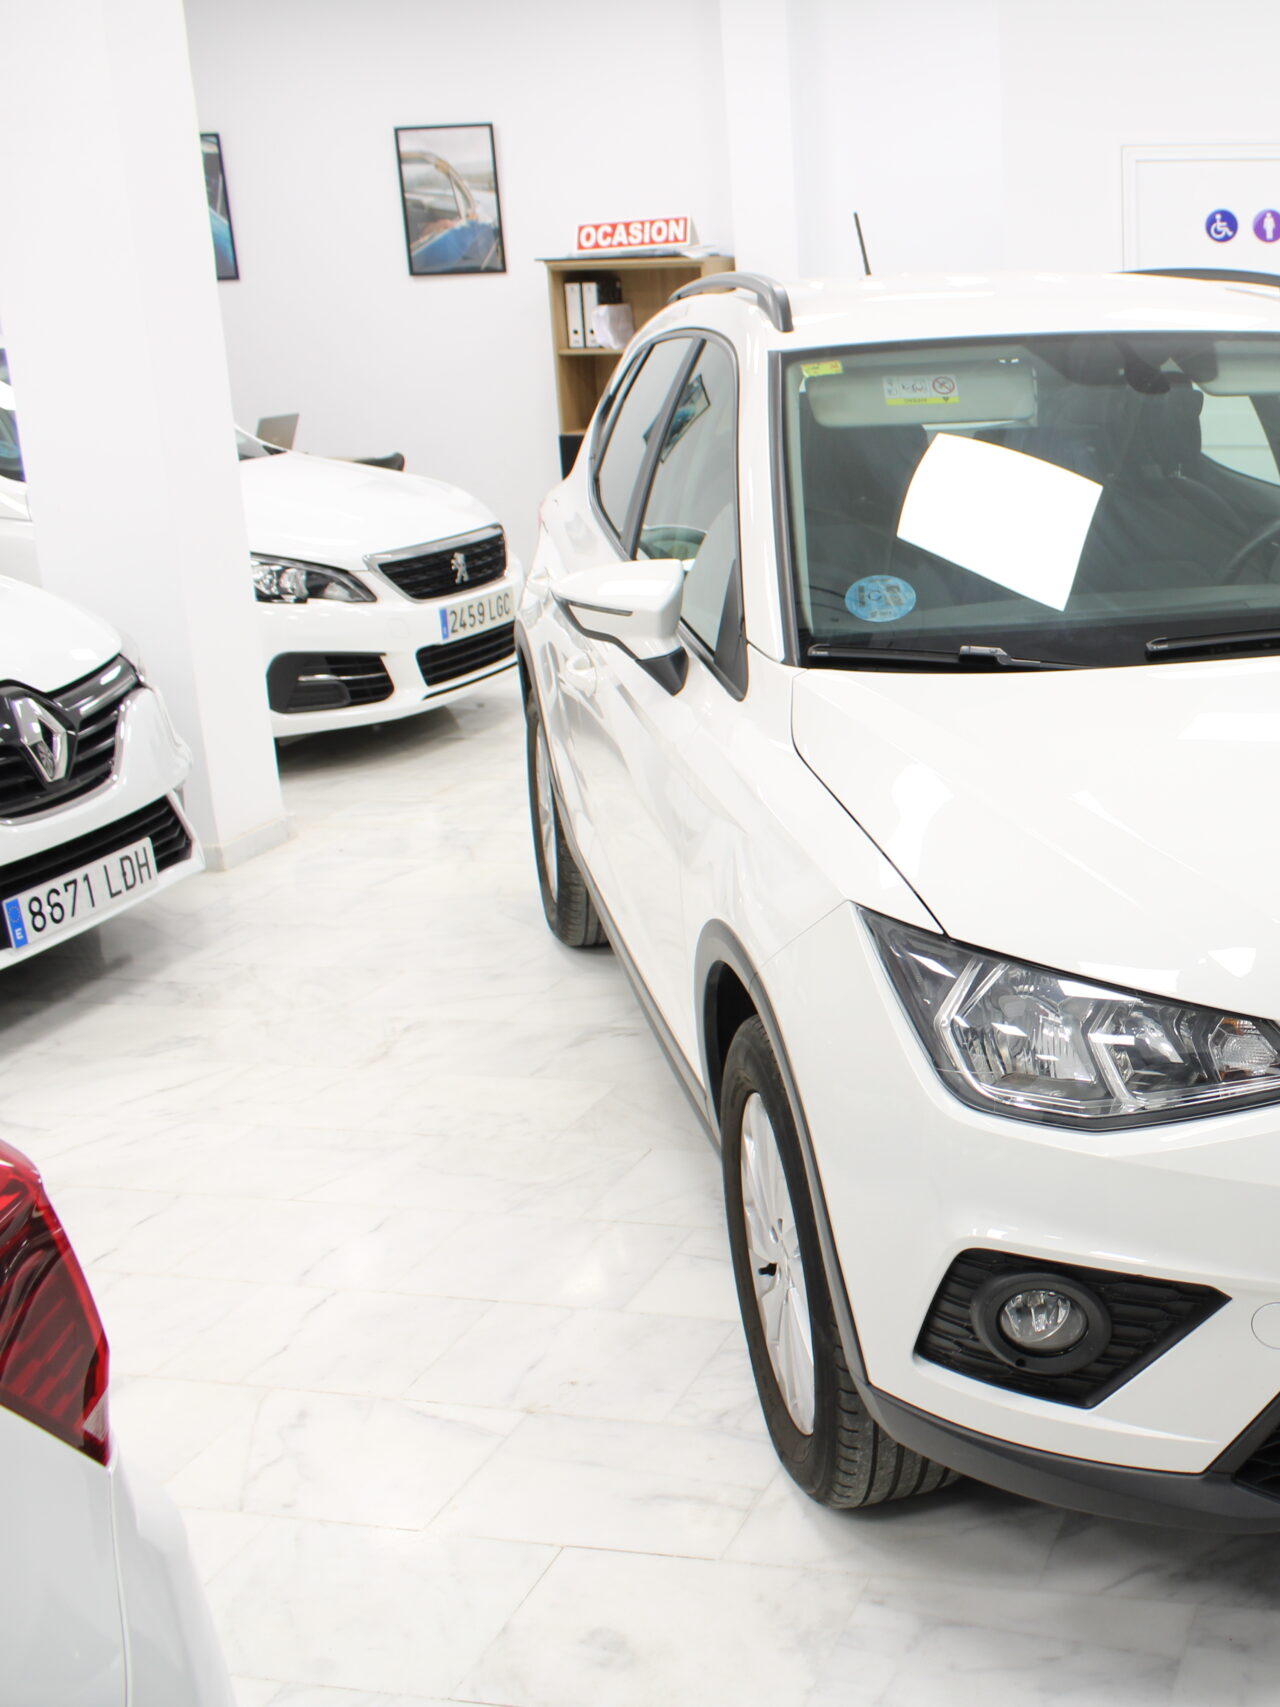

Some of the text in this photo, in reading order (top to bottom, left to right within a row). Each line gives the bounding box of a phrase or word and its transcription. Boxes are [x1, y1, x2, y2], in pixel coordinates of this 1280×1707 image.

[579, 218, 685, 248] OCASION
[450, 602, 485, 633] 2459
[15, 847, 151, 940] E 8671 LDH
